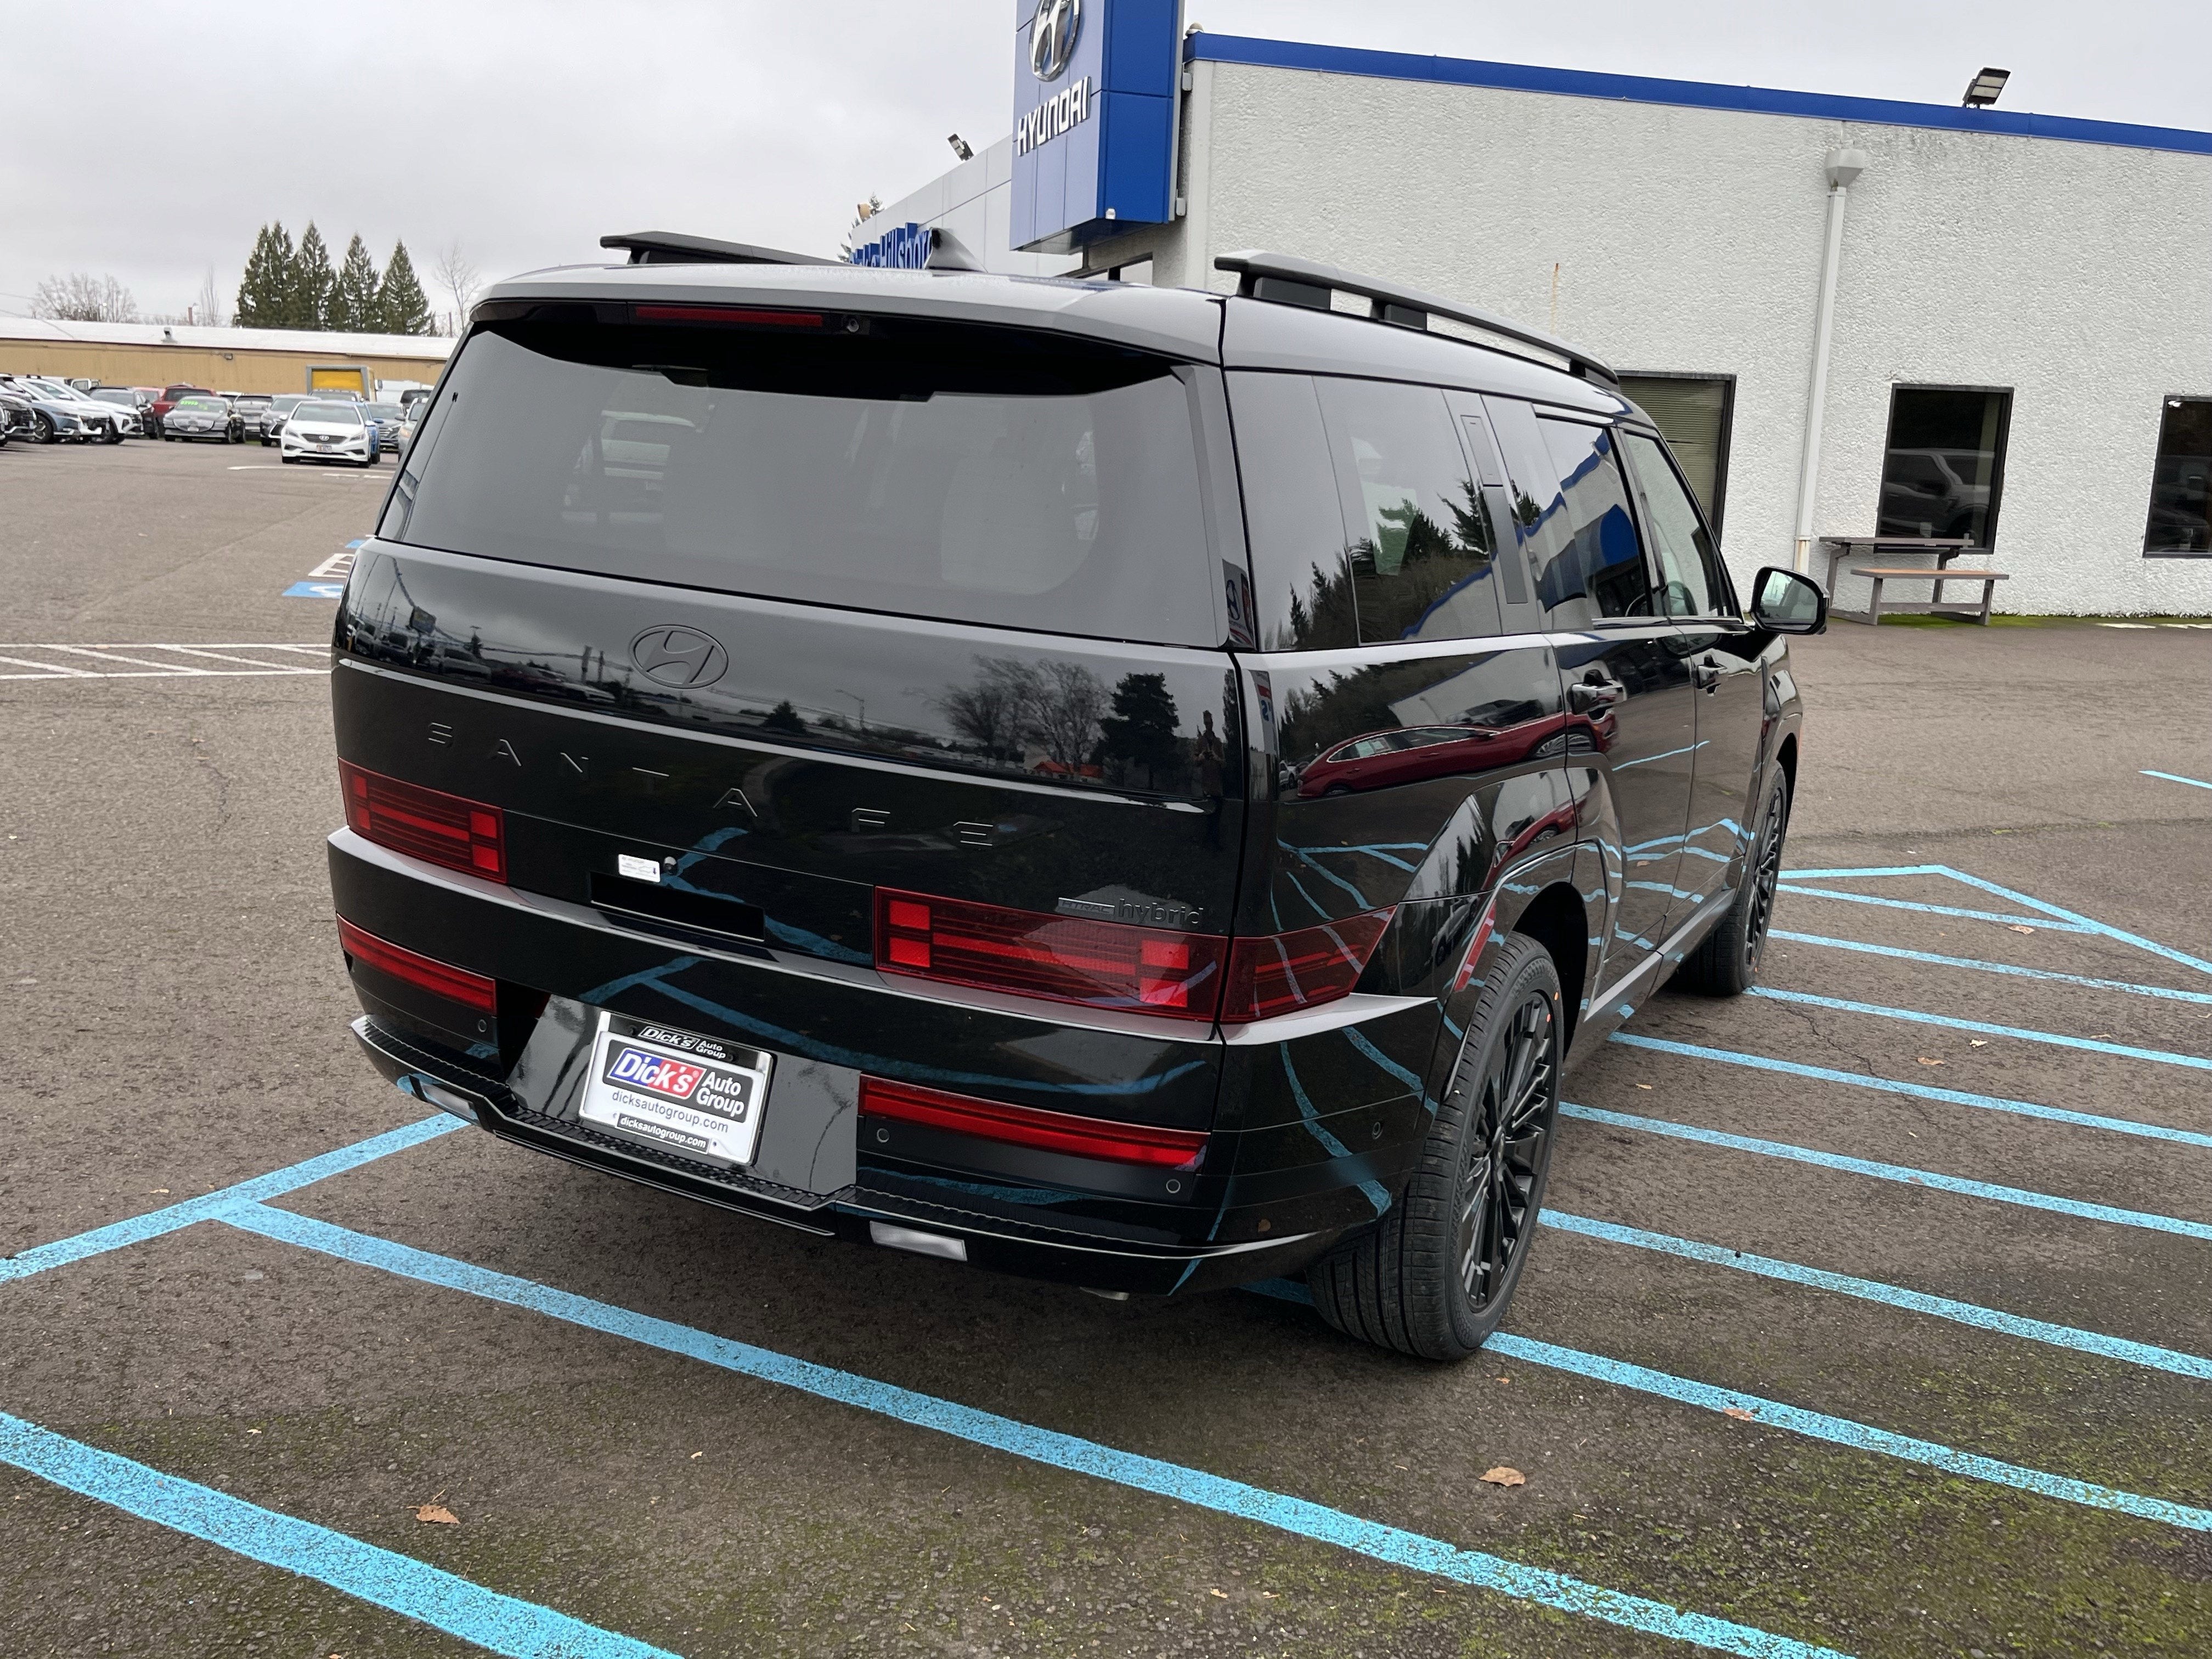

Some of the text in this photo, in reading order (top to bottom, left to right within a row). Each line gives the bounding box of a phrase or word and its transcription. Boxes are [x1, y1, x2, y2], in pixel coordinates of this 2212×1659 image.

[1017, 76, 1090, 156] HYUNDAI
[428, 721, 994, 847] SANTA FE
[1118, 897, 1204, 928] hybrid
[643, 1028, 693, 1047] Dick's
[695, 1045, 726, 1059] Group
[699, 1040, 723, 1052] Auto
[614, 1052, 694, 1093] Dick's
[701, 1071, 742, 1096] Auto
[612, 1090, 729, 1133] dicksautogroup.com
[696, 1087, 745, 1118] Group
[620, 1116, 707, 1149] dicksautogroup.com
